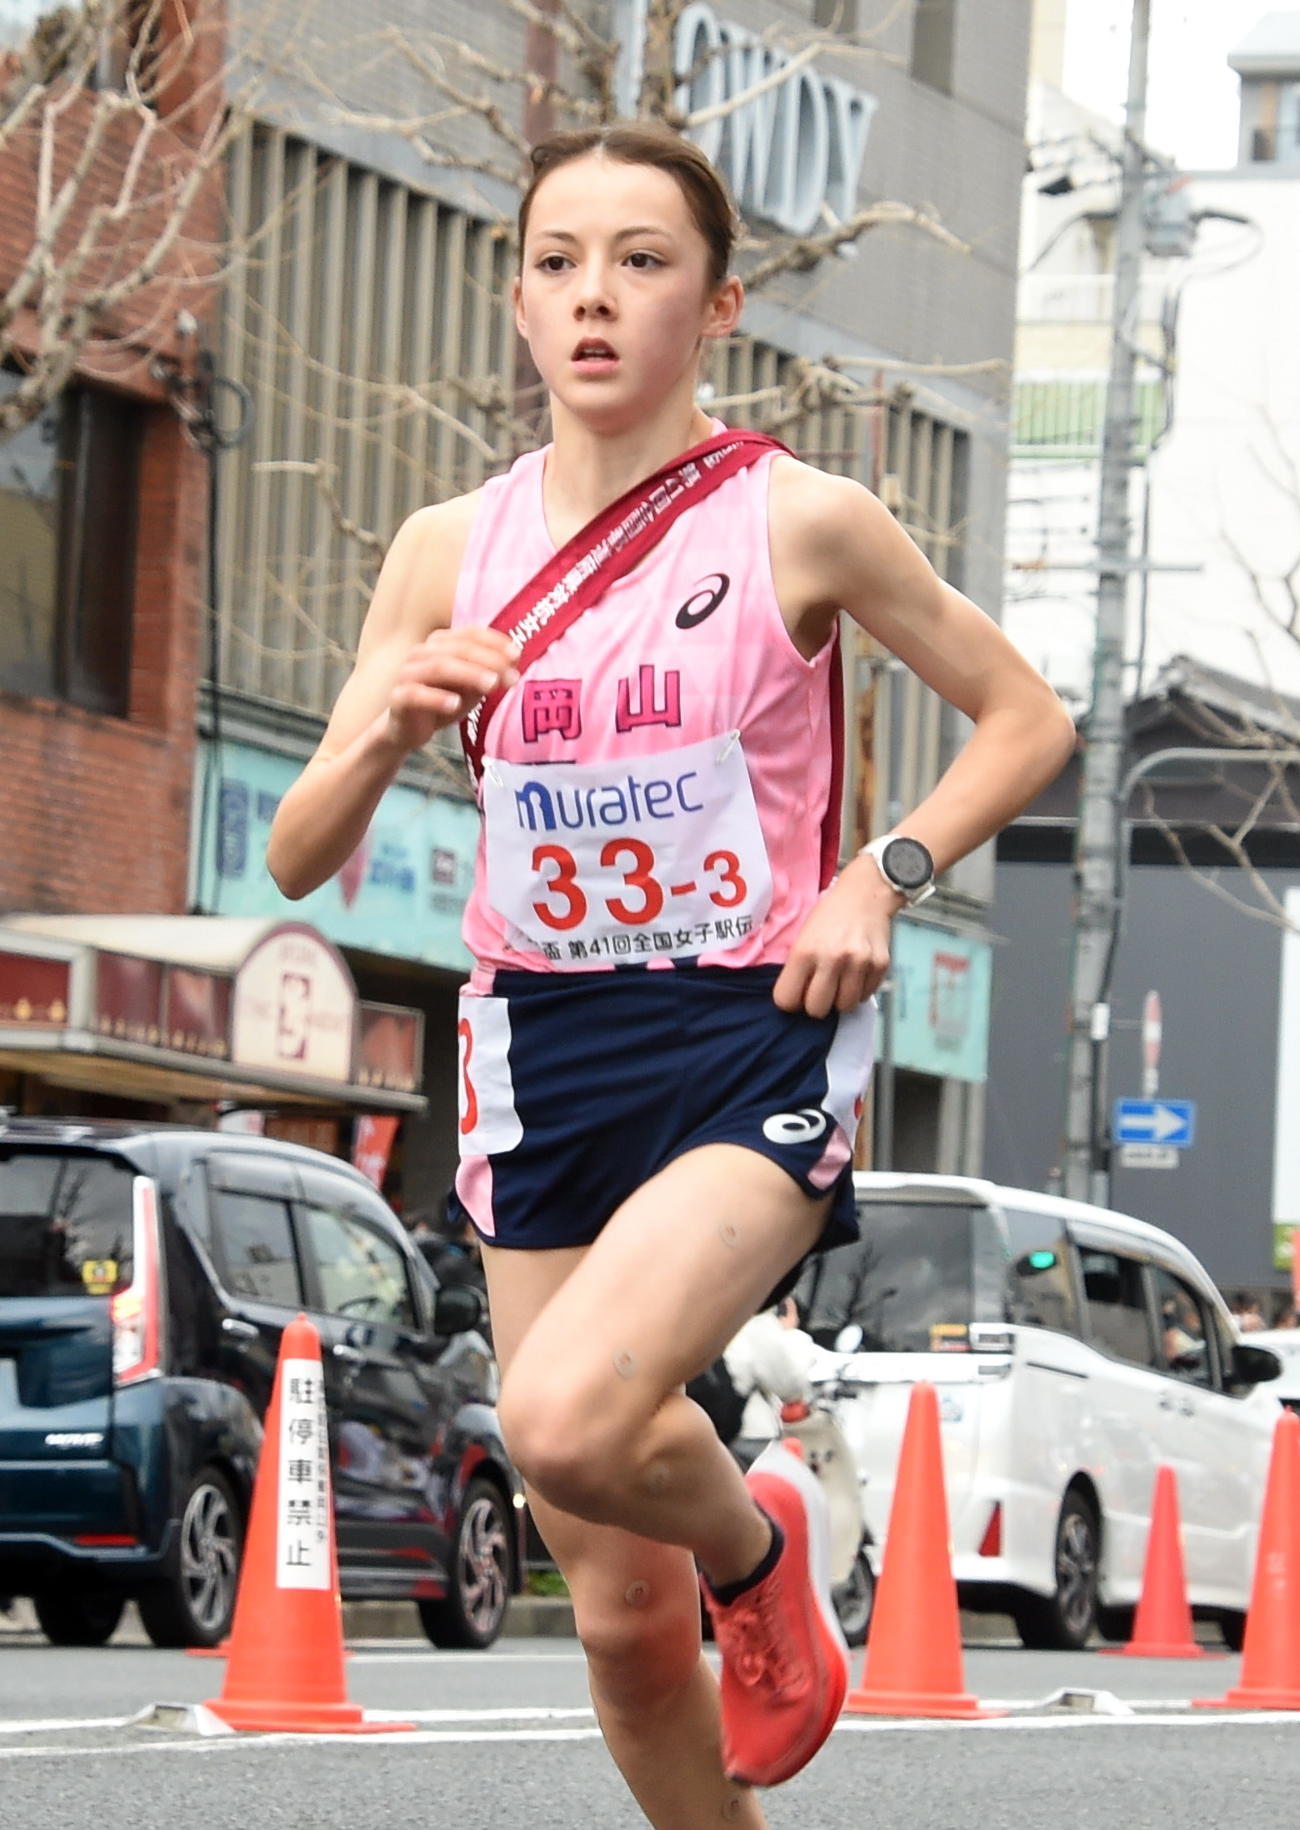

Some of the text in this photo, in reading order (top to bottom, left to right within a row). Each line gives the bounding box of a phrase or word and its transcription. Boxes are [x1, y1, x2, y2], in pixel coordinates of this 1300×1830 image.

[520, 663, 683, 744] 岡山
[285, 1376, 313, 1567] 駐停車禁止
